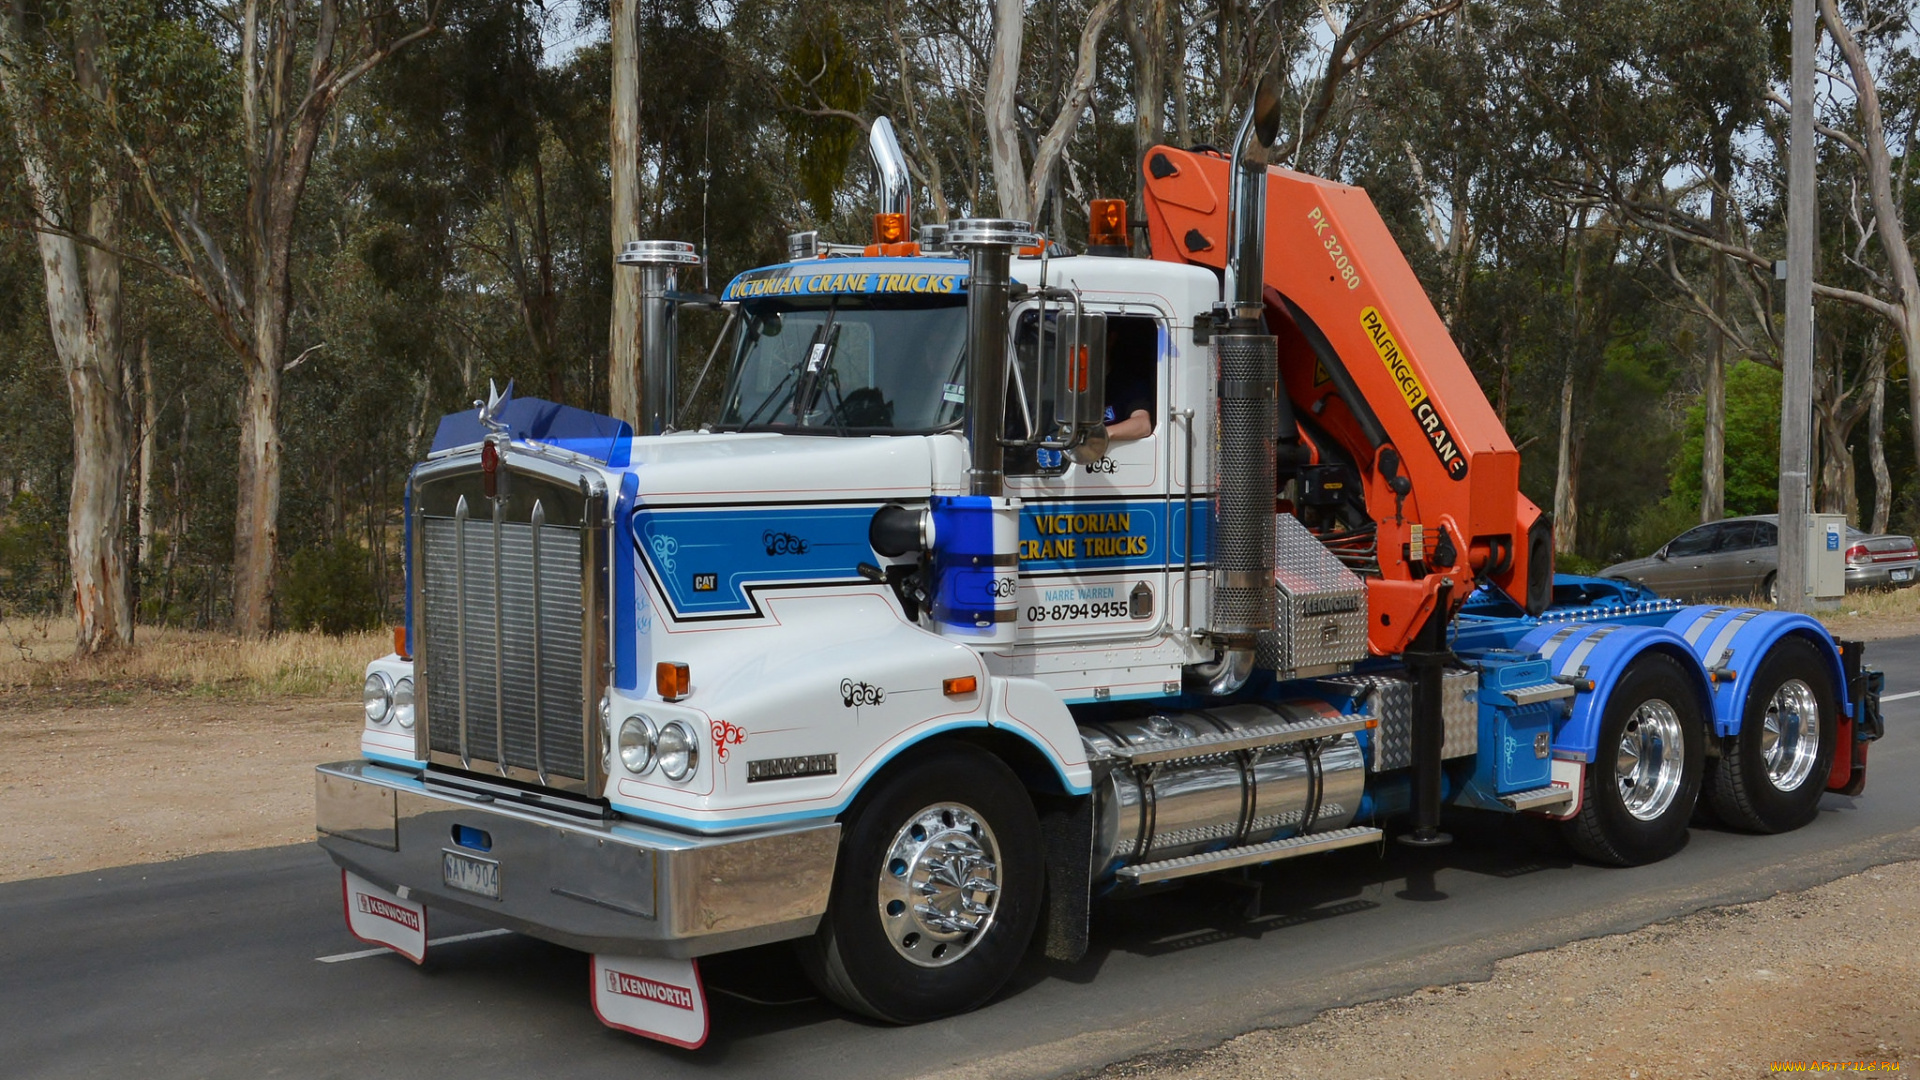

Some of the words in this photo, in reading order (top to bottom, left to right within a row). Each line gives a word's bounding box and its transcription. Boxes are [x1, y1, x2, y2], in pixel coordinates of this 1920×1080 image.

[1308, 206, 1330, 236] PK
[1324, 234, 1361, 291] 32080
[729, 276, 804, 299] VICTORIAN
[807, 273, 868, 293] CRANE
[876, 273, 955, 294] TRUCKS
[1363, 310, 1422, 404] PALFINGER
[1416, 403, 1464, 474] CRANE
[1035, 512, 1131, 535] VICTORIAN
[1019, 538, 1077, 560] CRANE
[1084, 535, 1148, 557] TRUCKS
[695, 575, 715, 590] CAT
[1045, 589, 1075, 602] NARRE
[1078, 587, 1115, 600] WARREN
[1304, 596, 1359, 614] KENWORTH
[749, 754, 837, 778] KENWORTH
[370, 899, 418, 929] KENWORTH
[621, 976, 691, 1007] KENWORTH
